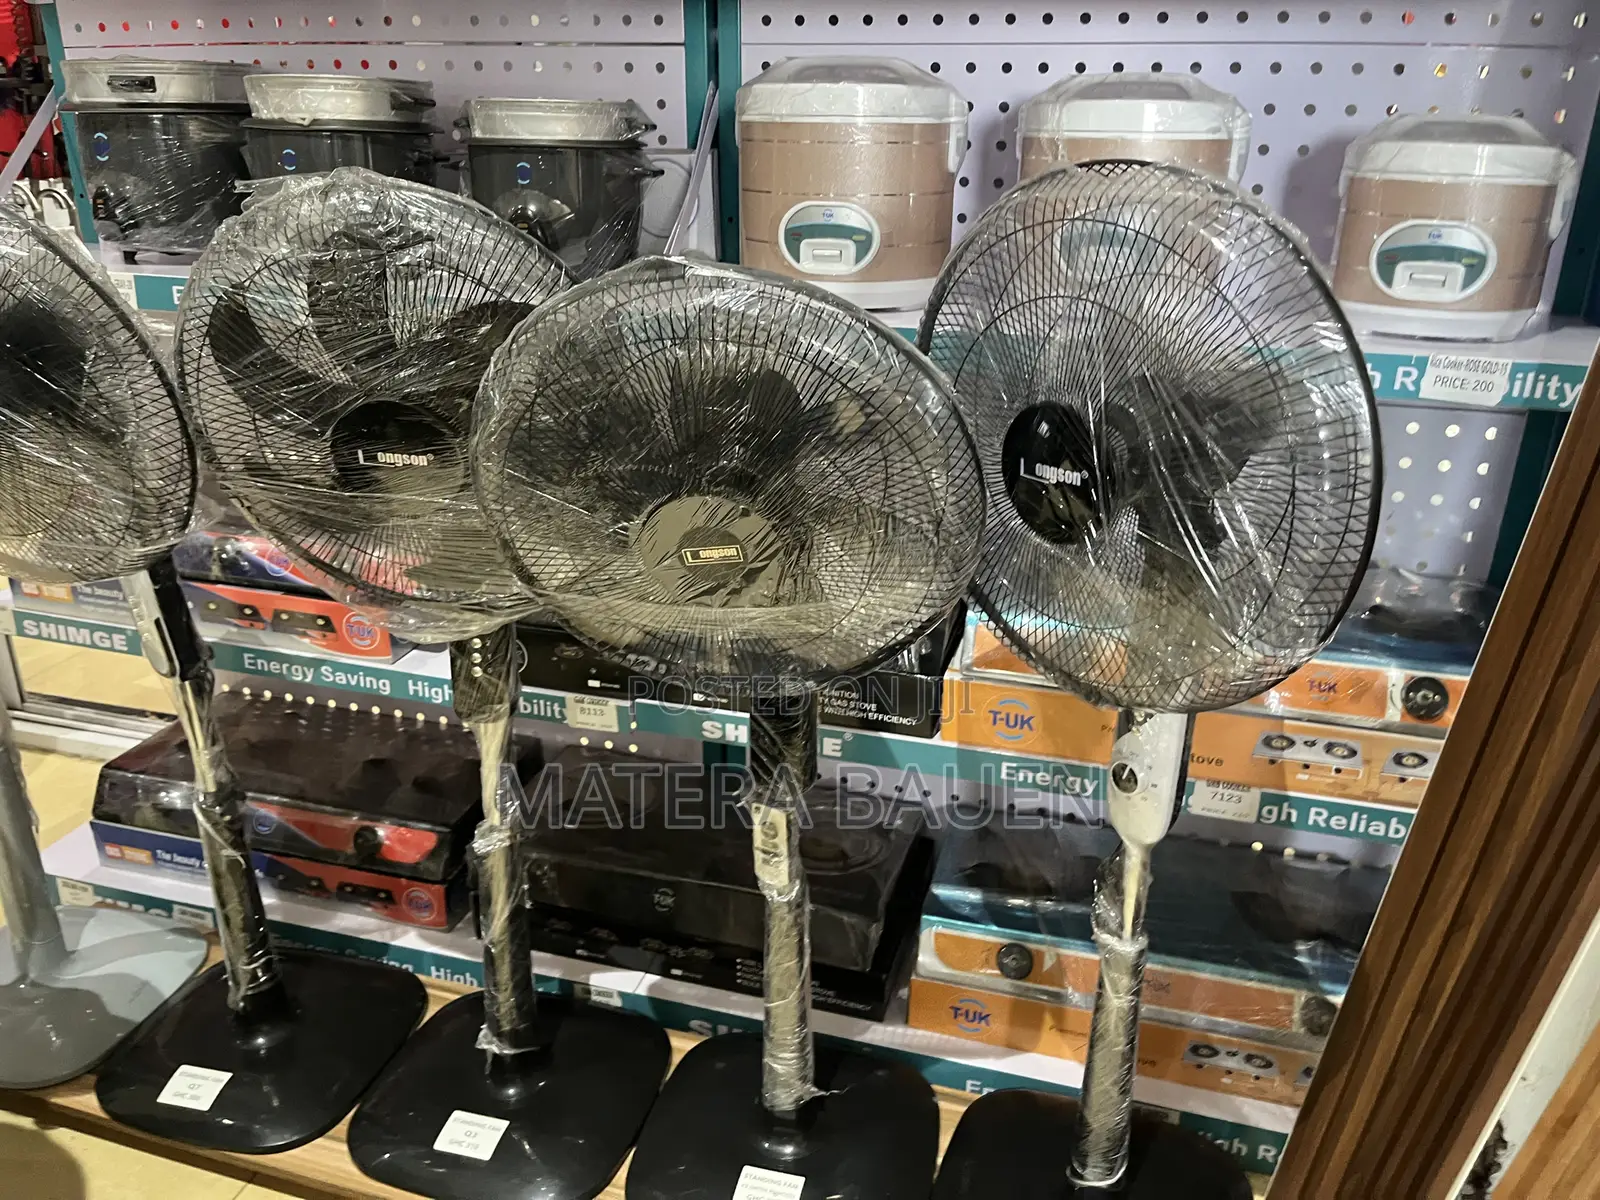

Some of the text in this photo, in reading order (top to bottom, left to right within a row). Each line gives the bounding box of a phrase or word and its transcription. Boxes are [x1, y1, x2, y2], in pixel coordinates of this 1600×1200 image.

[1471, 379, 1495, 393] 200
[22, 619, 129, 651] SHIMGE
[242, 652, 454, 704] Energy Saving High
[868, 712, 918, 726] EFFICIENCY
[988, 709, 1036, 731] T-UK
[1190, 752, 1224, 767] tove
[1000, 761, 1099, 796] Energy
[1210, 791, 1243, 804] 7123
[1307, 806, 1407, 839] Reliab
[949, 1005, 992, 1027] T-UK
